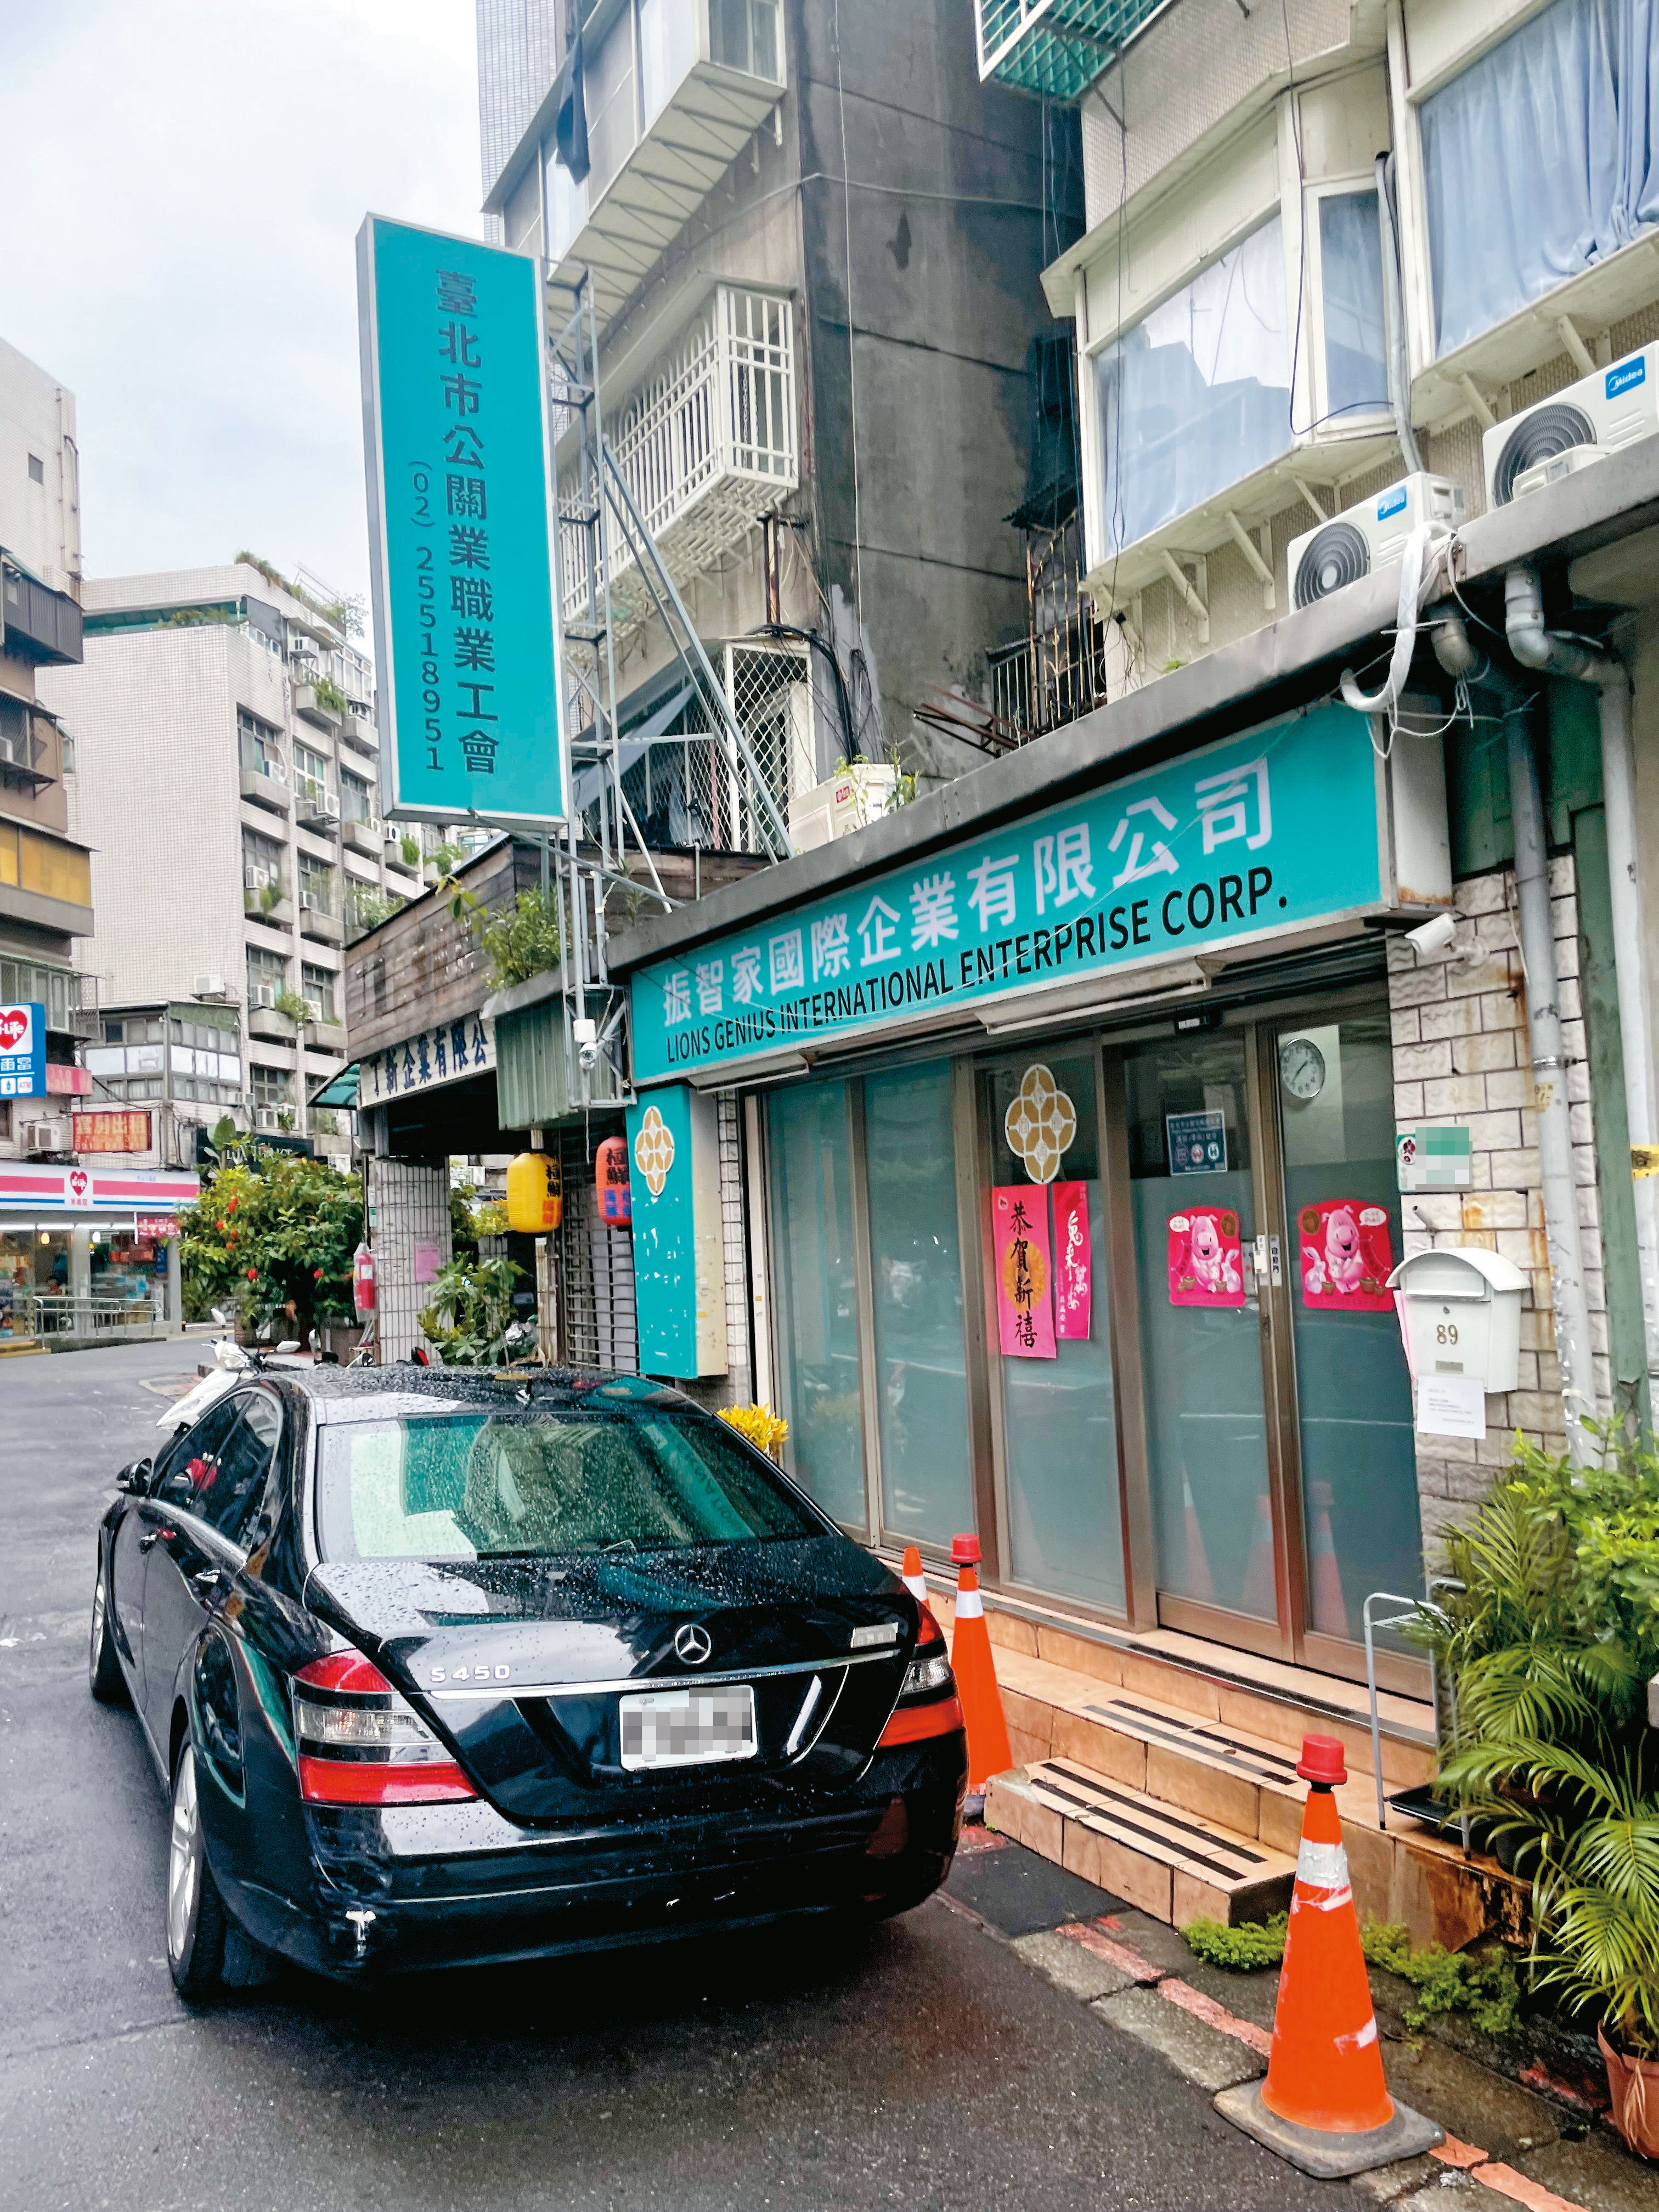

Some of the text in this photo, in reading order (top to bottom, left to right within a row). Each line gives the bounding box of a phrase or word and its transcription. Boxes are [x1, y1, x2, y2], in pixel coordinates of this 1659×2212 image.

[1610, 367, 1643, 392] Midea
[435, 268, 499, 775] 臺北市公關業職業工會
[1379, 496, 1405, 515] Midea
[415, 546, 444, 771] 25518951
[662, 756, 1273, 1027] 振智家國際企業有限公司
[665, 865, 1288, 1064] LIONS GENIUS INTERNATIONAL ENTERPRISE CORP.
[19, 1081, 32, 1090] ATM
[1009, 1200, 1038, 1348] 恭賀新禧
[1437, 1324, 1458, 1345] 89
